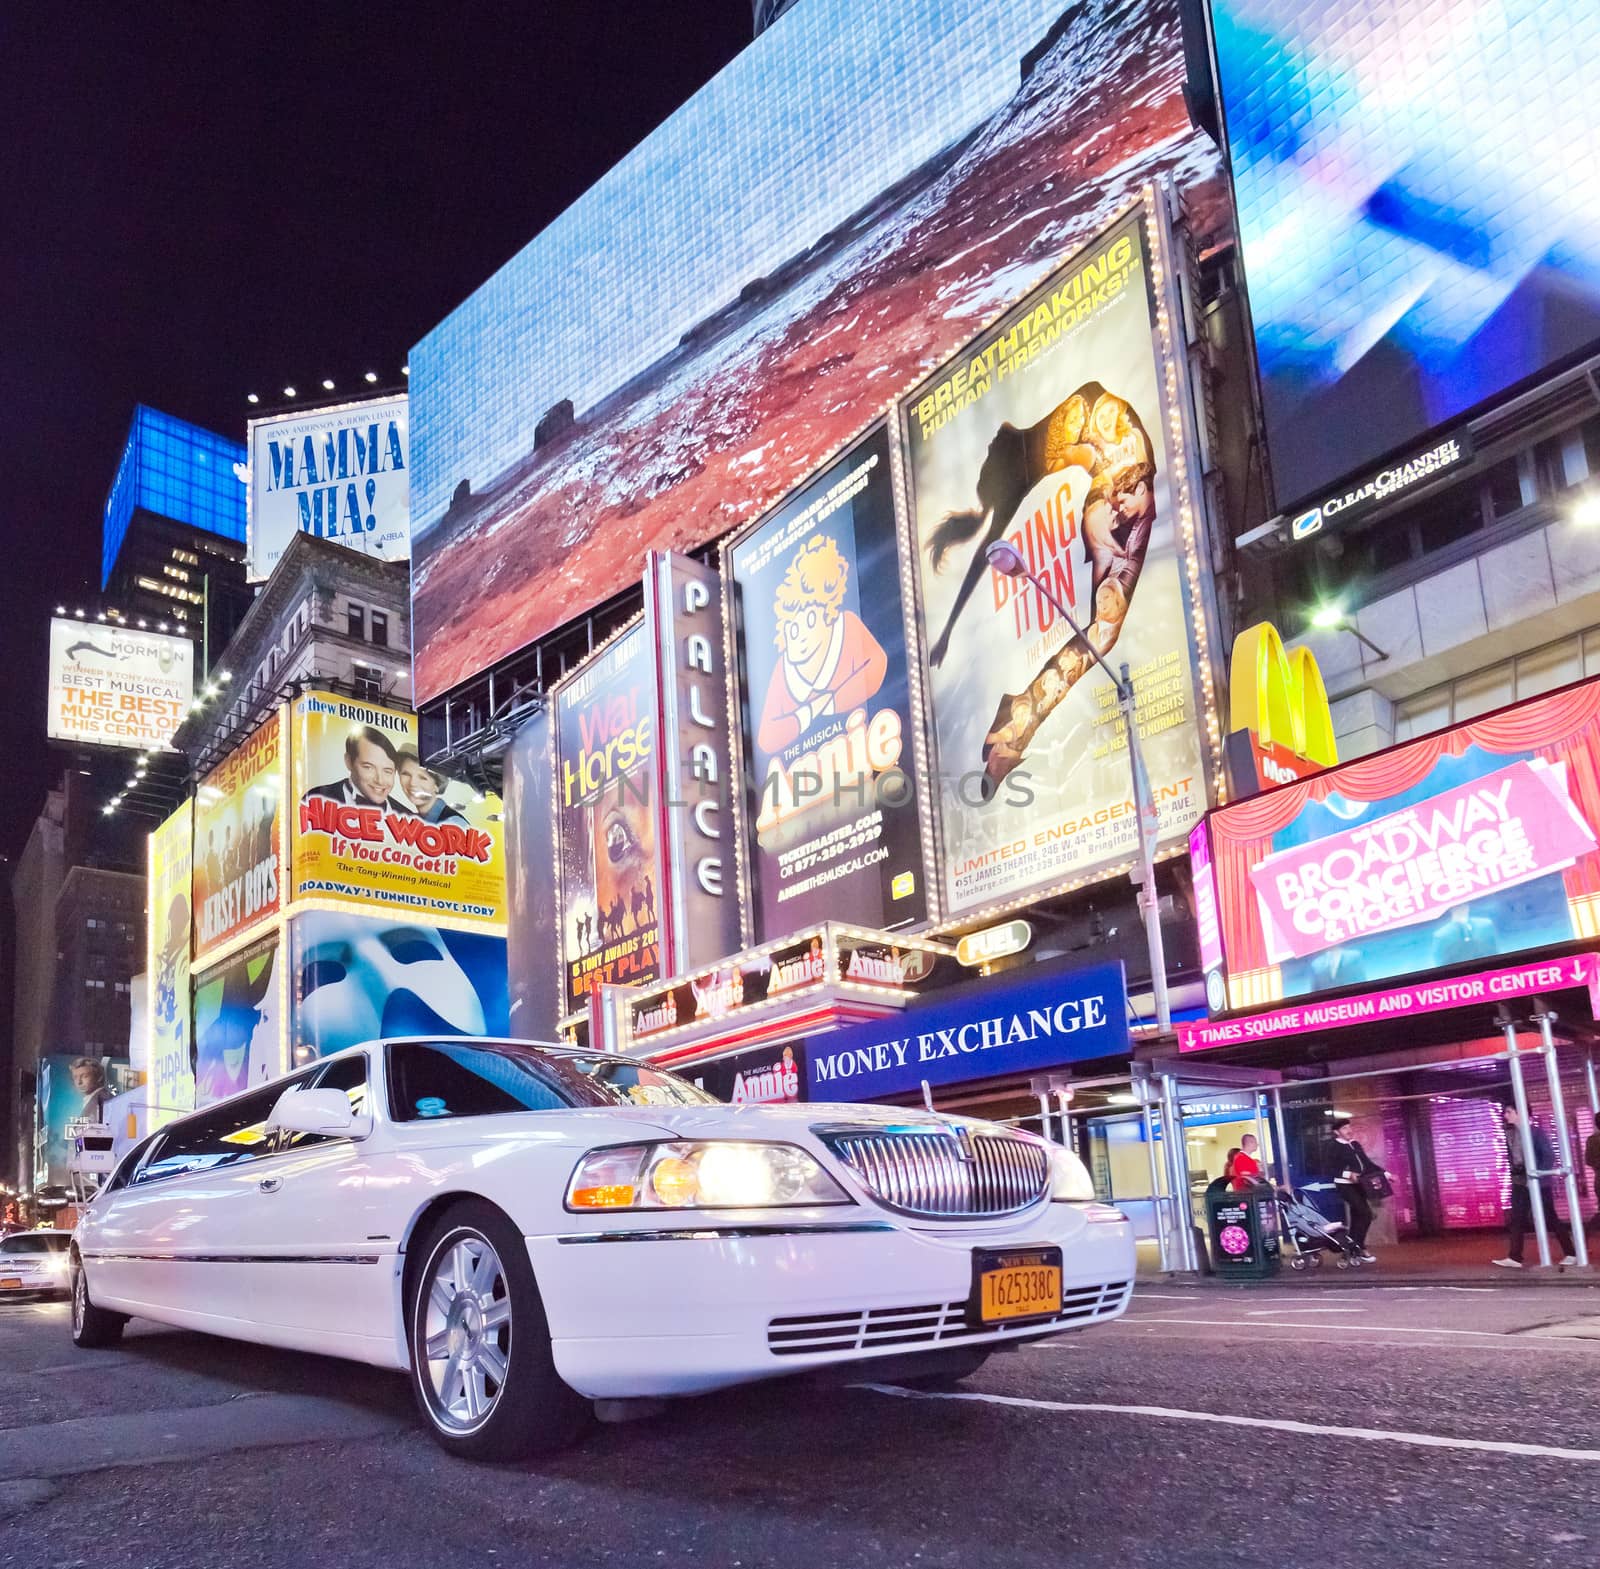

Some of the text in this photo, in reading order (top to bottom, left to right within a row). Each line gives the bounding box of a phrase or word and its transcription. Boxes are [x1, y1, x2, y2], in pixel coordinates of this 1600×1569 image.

[922, 374, 992, 441] HUMAN
[266, 420, 405, 492] MAMMA
[1375, 450, 1460, 500] SPECTACOLOR
[296, 478, 376, 538] MIA!
[380, 531, 405, 542] ABBA
[773, 518, 816, 557] MUSICAL
[1013, 547, 1076, 640] IT ON
[62, 673, 184, 700] BEST MUSICAL
[120, 694, 183, 718] BEST
[1135, 683, 1172, 709] AVENUE
[1145, 693, 1185, 721] HEIGHTS
[61, 703, 151, 726] MUSICAL
[61, 717, 100, 732] THIS
[339, 703, 409, 734] BRODERICK
[578, 685, 640, 756] War
[1110, 733, 1127, 752] NEX
[1147, 709, 1185, 737] NORMAL
[229, 722, 280, 774] CROWD
[683, 579, 723, 897] PALACE
[784, 721, 843, 761] THE MUSICAL
[564, 715, 651, 807] Horse
[756, 708, 903, 832] Annie
[299, 797, 492, 864] NICE WORK
[778, 810, 883, 867] TICKETMASTER.COM
[1276, 779, 1513, 911] BROADWAY
[332, 836, 457, 875] If You Can Get It
[780, 825, 882, 879] OR 877-250-2929
[954, 840, 1027, 877] LIMITED
[976, 864, 1001, 882] JAMES
[1003, 851, 1041, 872] THEATRE,
[1042, 843, 1059, 857] 246
[336, 862, 451, 889] The Tony-Winning Musical
[778, 846, 889, 903] ANNIETHEMUSICAL.COM
[956, 874, 1016, 900] Telecharge.com
[1292, 817, 1529, 935] CONCIERGE
[1324, 845, 1538, 942] & TICKET CENTER
[201, 876, 243, 945] JERSEY
[245, 854, 278, 918] BOYS
[299, 880, 495, 916] BROADWAY'S FUNNIEST LOVE STORY
[582, 951, 602, 973] TONY
[968, 926, 1020, 959] FUEL
[573, 962, 615, 997] BEST
[767, 952, 825, 996] Annie
[636, 1001, 677, 1034] Annie
[1201, 967, 1563, 1044] TIMES SQUARE MUSEUM AND VISITOR CENTER
[812, 995, 1107, 1084] MONEY EXCHANGE
[731, 1062, 799, 1104] Annie
[69, 1116, 89, 1124] THE
[989, 1269, 1054, 1307] T625338C
